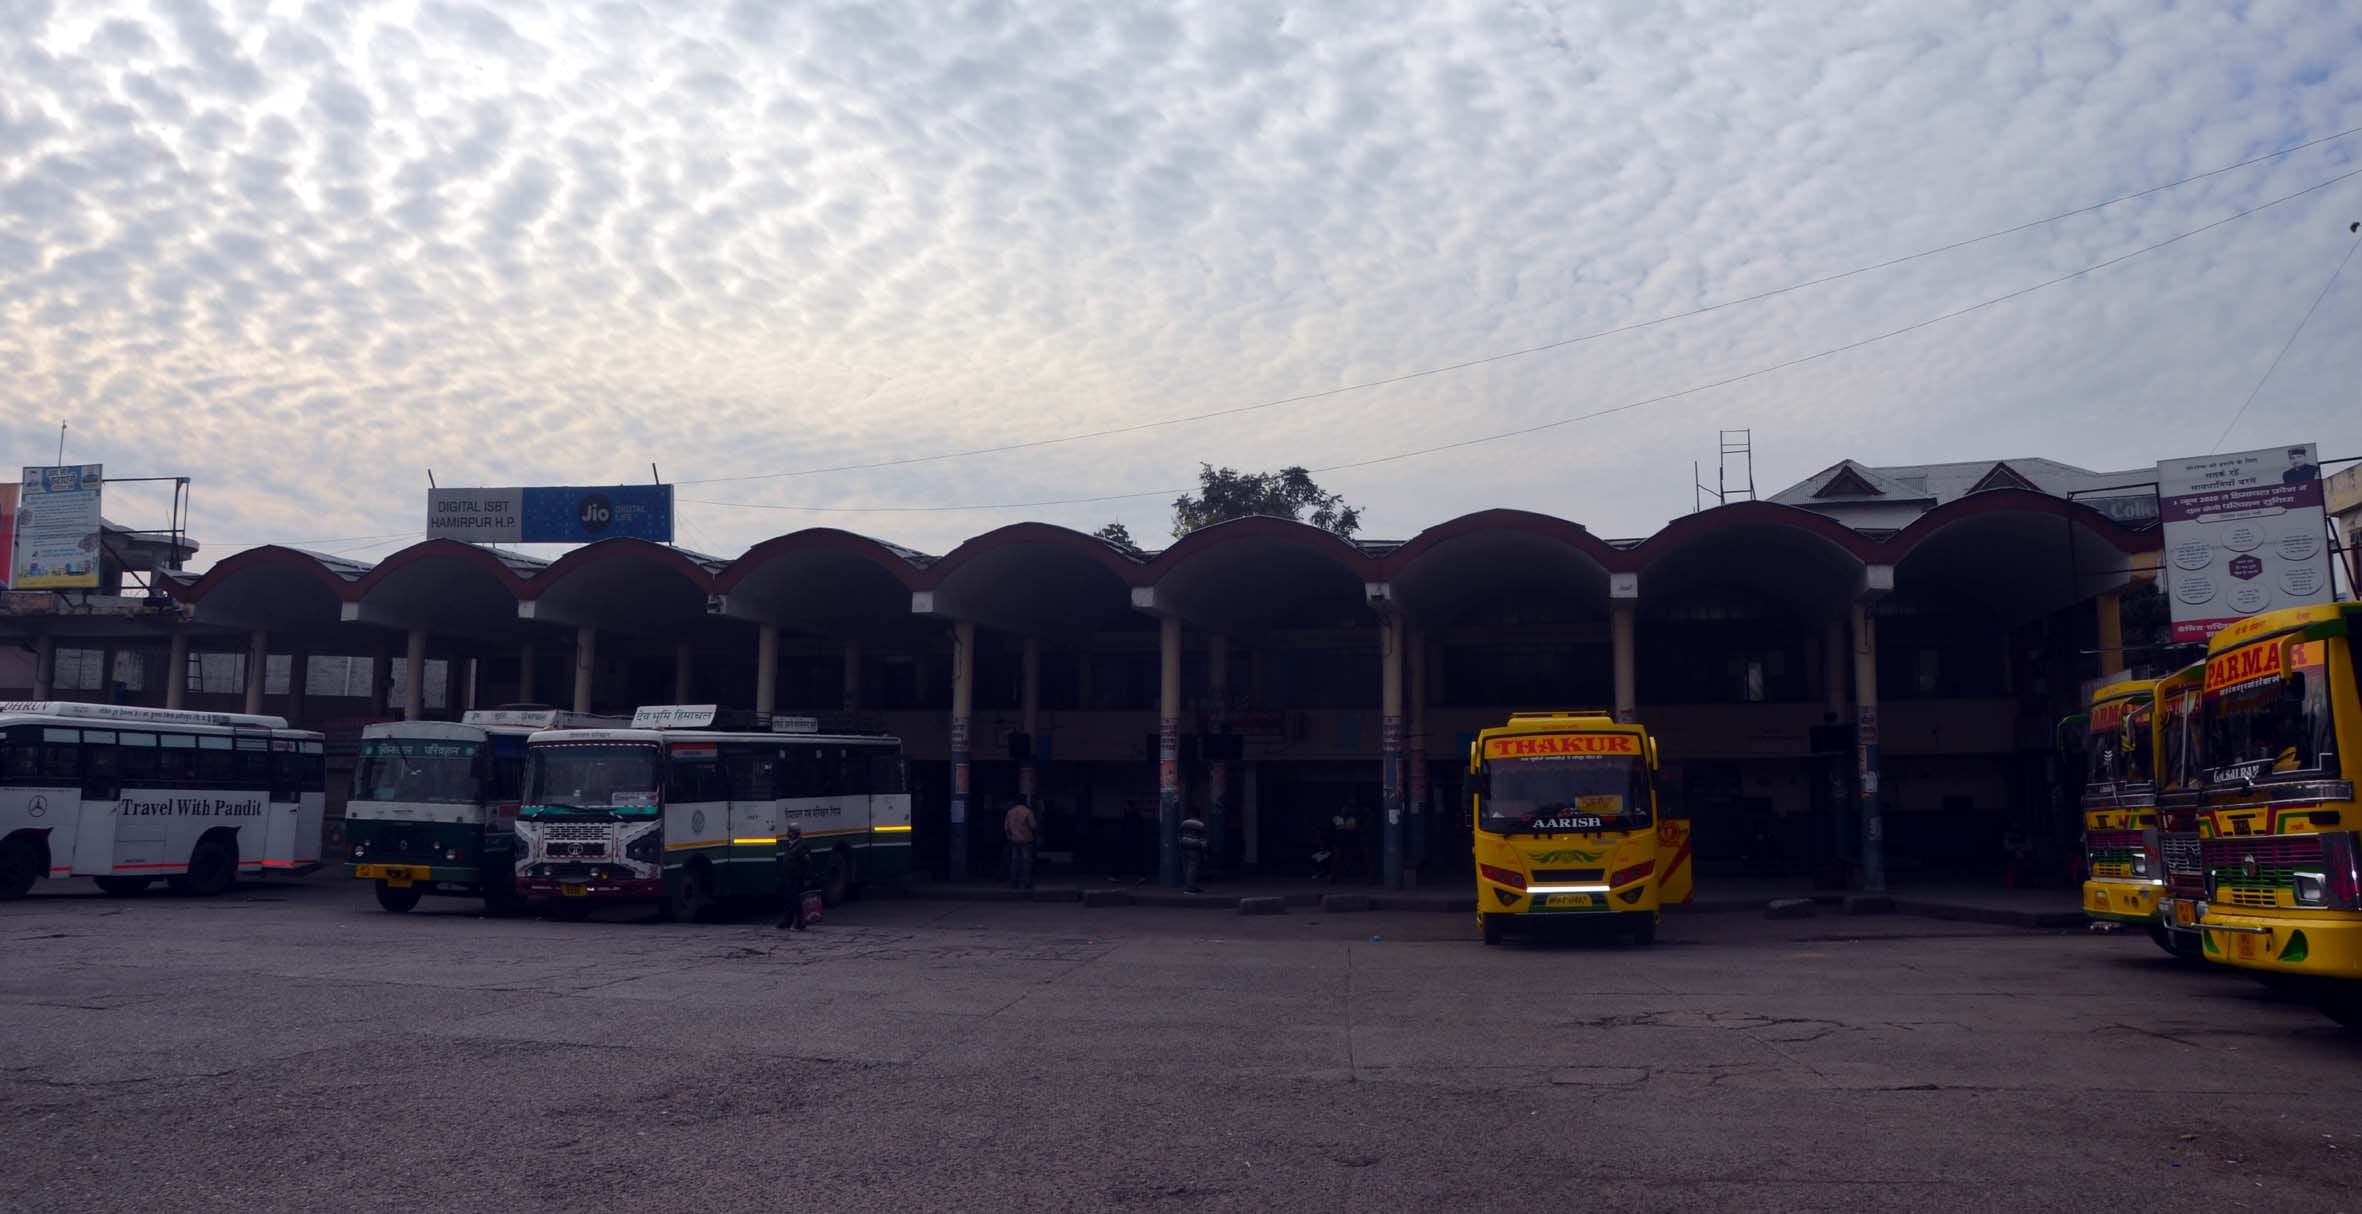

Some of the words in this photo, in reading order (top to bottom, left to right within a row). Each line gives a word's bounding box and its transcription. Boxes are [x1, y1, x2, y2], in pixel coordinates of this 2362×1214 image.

[438, 501, 482, 512] DIGITAL
[484, 501, 510, 512] ISBT
[582, 504, 610, 522] Jio
[431, 516, 492, 528] HAMIRPUR
[674, 708, 714, 721] हिमाचल
[1494, 736, 1632, 756] THAKUR
[121, 798, 173, 816] Travel
[177, 798, 211, 816] With
[213, 799, 262, 816] Pandit
[1532, 817, 1602, 828] AARISH
